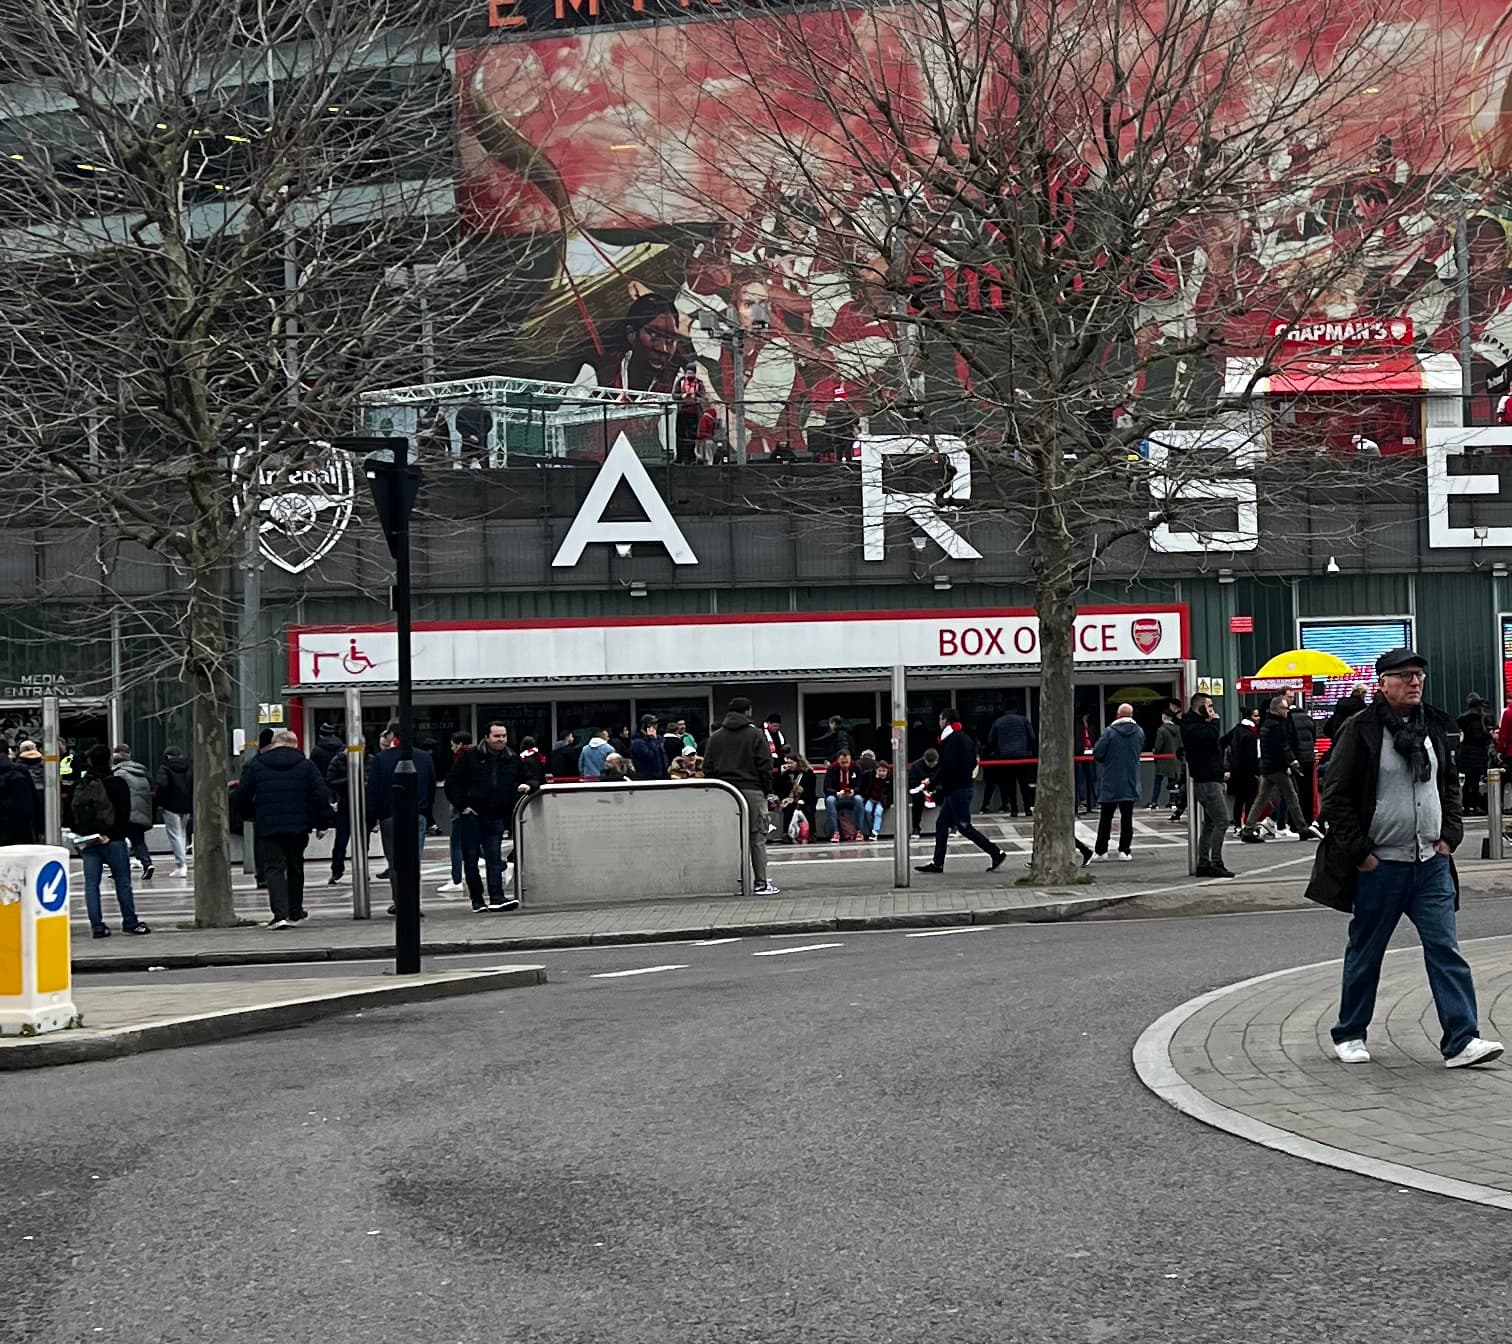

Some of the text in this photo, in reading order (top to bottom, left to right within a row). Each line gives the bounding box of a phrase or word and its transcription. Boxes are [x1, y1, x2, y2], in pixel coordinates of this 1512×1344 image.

[246, 460, 337, 485] Arenal
[939, 624, 1118, 656] BOX OICE
[21, 675, 65, 685] MEDIA
